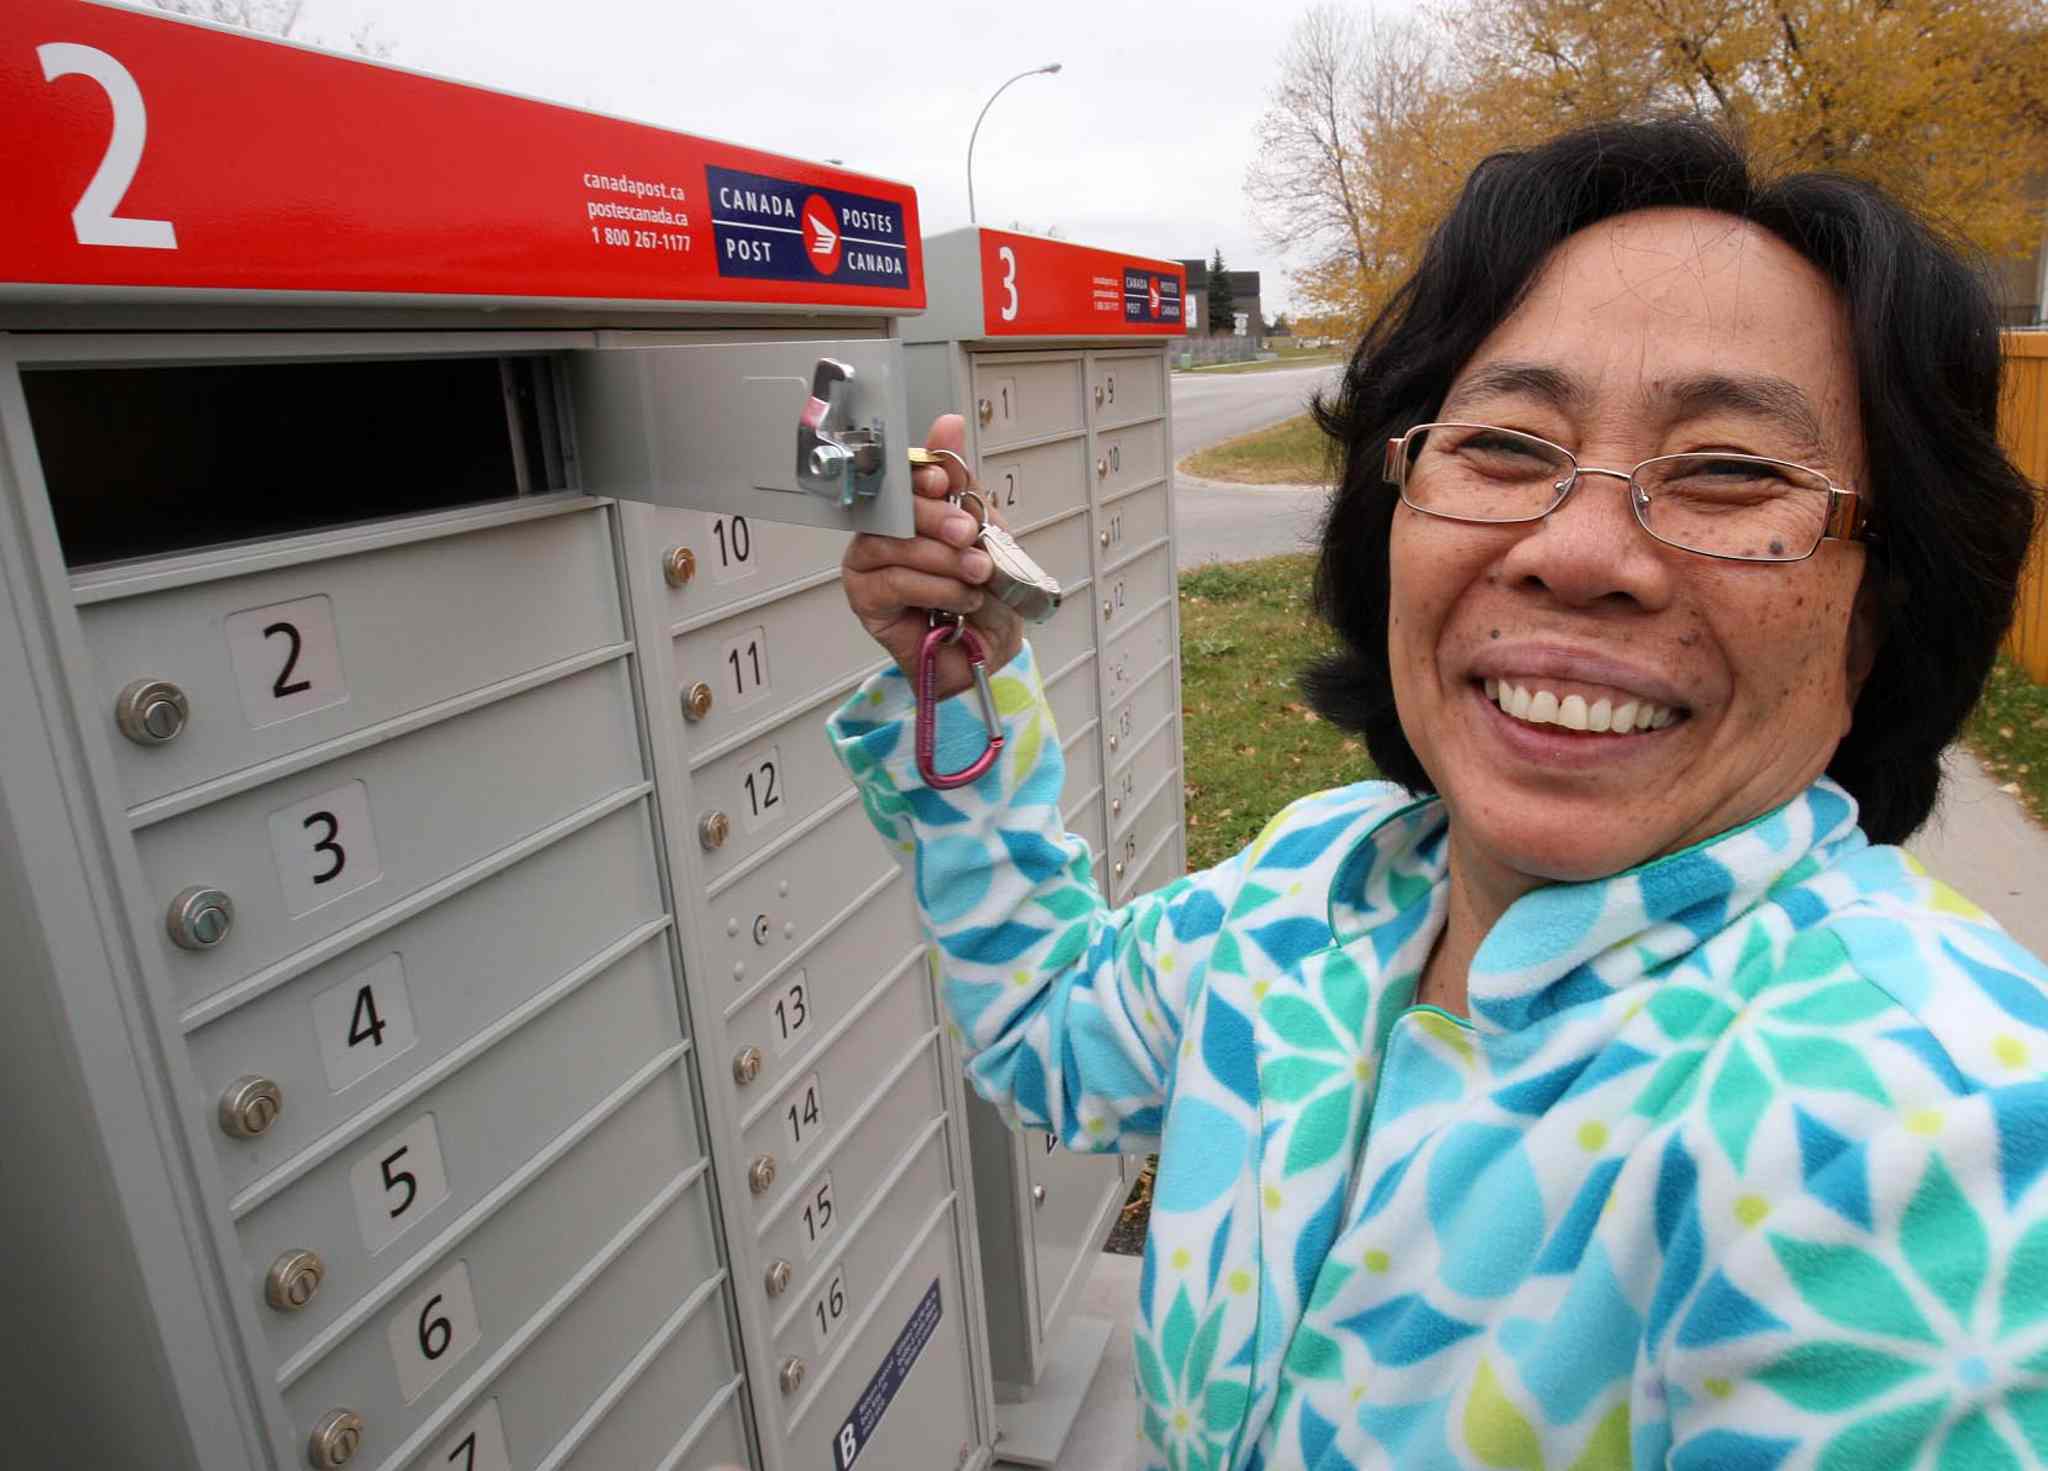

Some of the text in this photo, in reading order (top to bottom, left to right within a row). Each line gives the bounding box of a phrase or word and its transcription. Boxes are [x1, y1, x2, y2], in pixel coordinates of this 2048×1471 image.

[36, 41, 178, 250] 2
[583, 173, 685, 200] canadapost.ca
[719, 187, 796, 219] CANADA
[587, 201, 689, 226] postescanada.ca
[592, 226, 691, 252] 1 800 267-1177
[842, 208, 893, 233] POSTES
[726, 238, 772, 262] POST
[847, 251, 904, 275] CANADA
[999, 246, 1018, 321] 3
[1002, 386, 1009, 419] 1
[1108, 446, 1120, 472] 10
[1006, 473, 1015, 506] 2
[713, 515, 750, 567] 10
[1111, 516, 1121, 542] 11
[263, 622, 312, 699] 2
[729, 641, 761, 694] 11
[744, 761, 779, 816] 12
[303, 811, 346, 885] 3
[347, 984, 386, 1048] 4
[775, 985, 806, 1039] 13
[788, 1086, 819, 1142] 14
[381, 1145, 417, 1218] 5
[803, 1184, 832, 1241] 15
[419, 1294, 452, 1360] 6
[816, 1277, 843, 1334] 16
[840, 1422, 857, 1469] B
